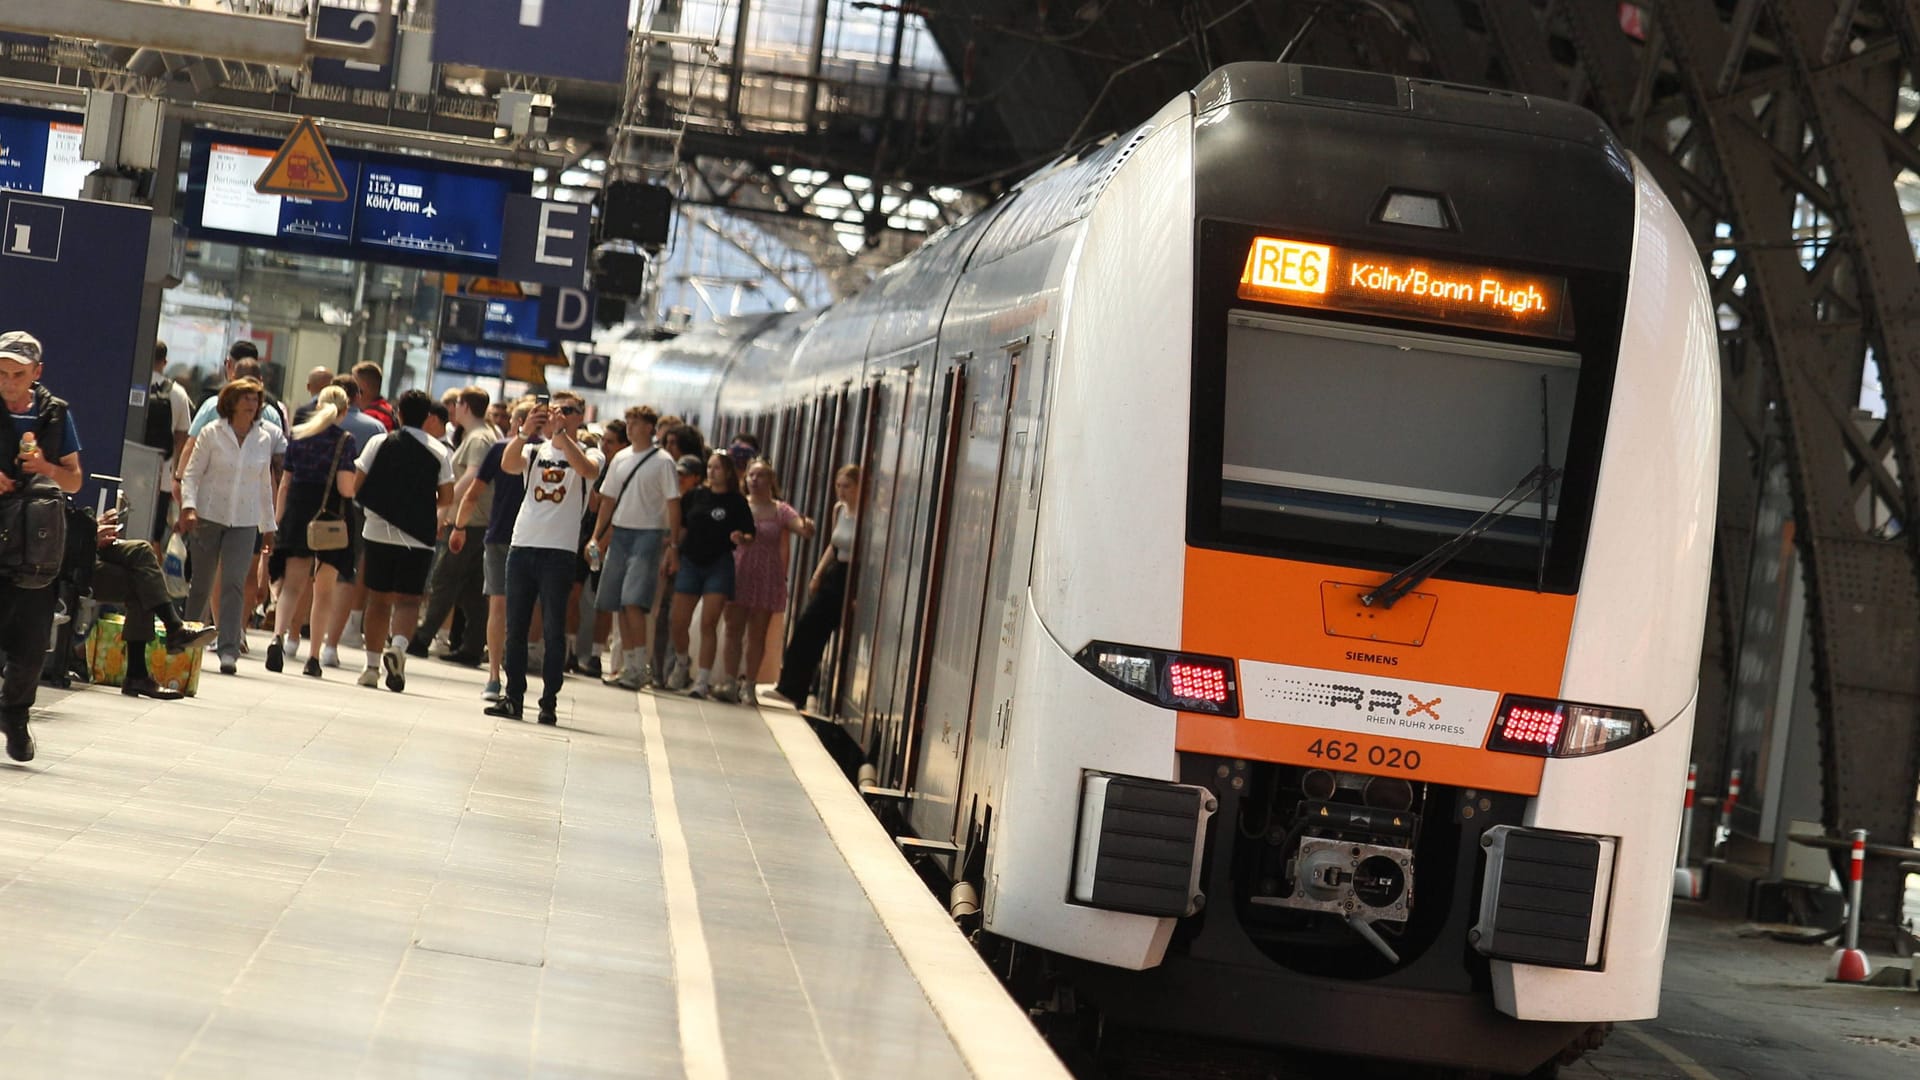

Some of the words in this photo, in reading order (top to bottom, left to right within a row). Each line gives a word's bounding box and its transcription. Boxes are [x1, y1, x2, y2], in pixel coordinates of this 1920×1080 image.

[368, 180, 396, 196] 11:52
[365, 194, 420, 214] Köln/Bonn
[535, 201, 578, 267] E
[1257, 243, 1322, 288] RE6
[1350, 261, 1473, 301] Köln/Bonn
[1479, 280, 1547, 313] Flugh.
[555, 287, 588, 330] D
[582, 354, 605, 384] C
[1345, 651, 1399, 666] SIEMENS
[1366, 714, 1397, 727] RHEIN
[1399, 718, 1427, 730] RUHR
[1428, 723, 1466, 736] XPRESS
[1307, 737, 1358, 763] 462
[1367, 744, 1422, 771] 020
